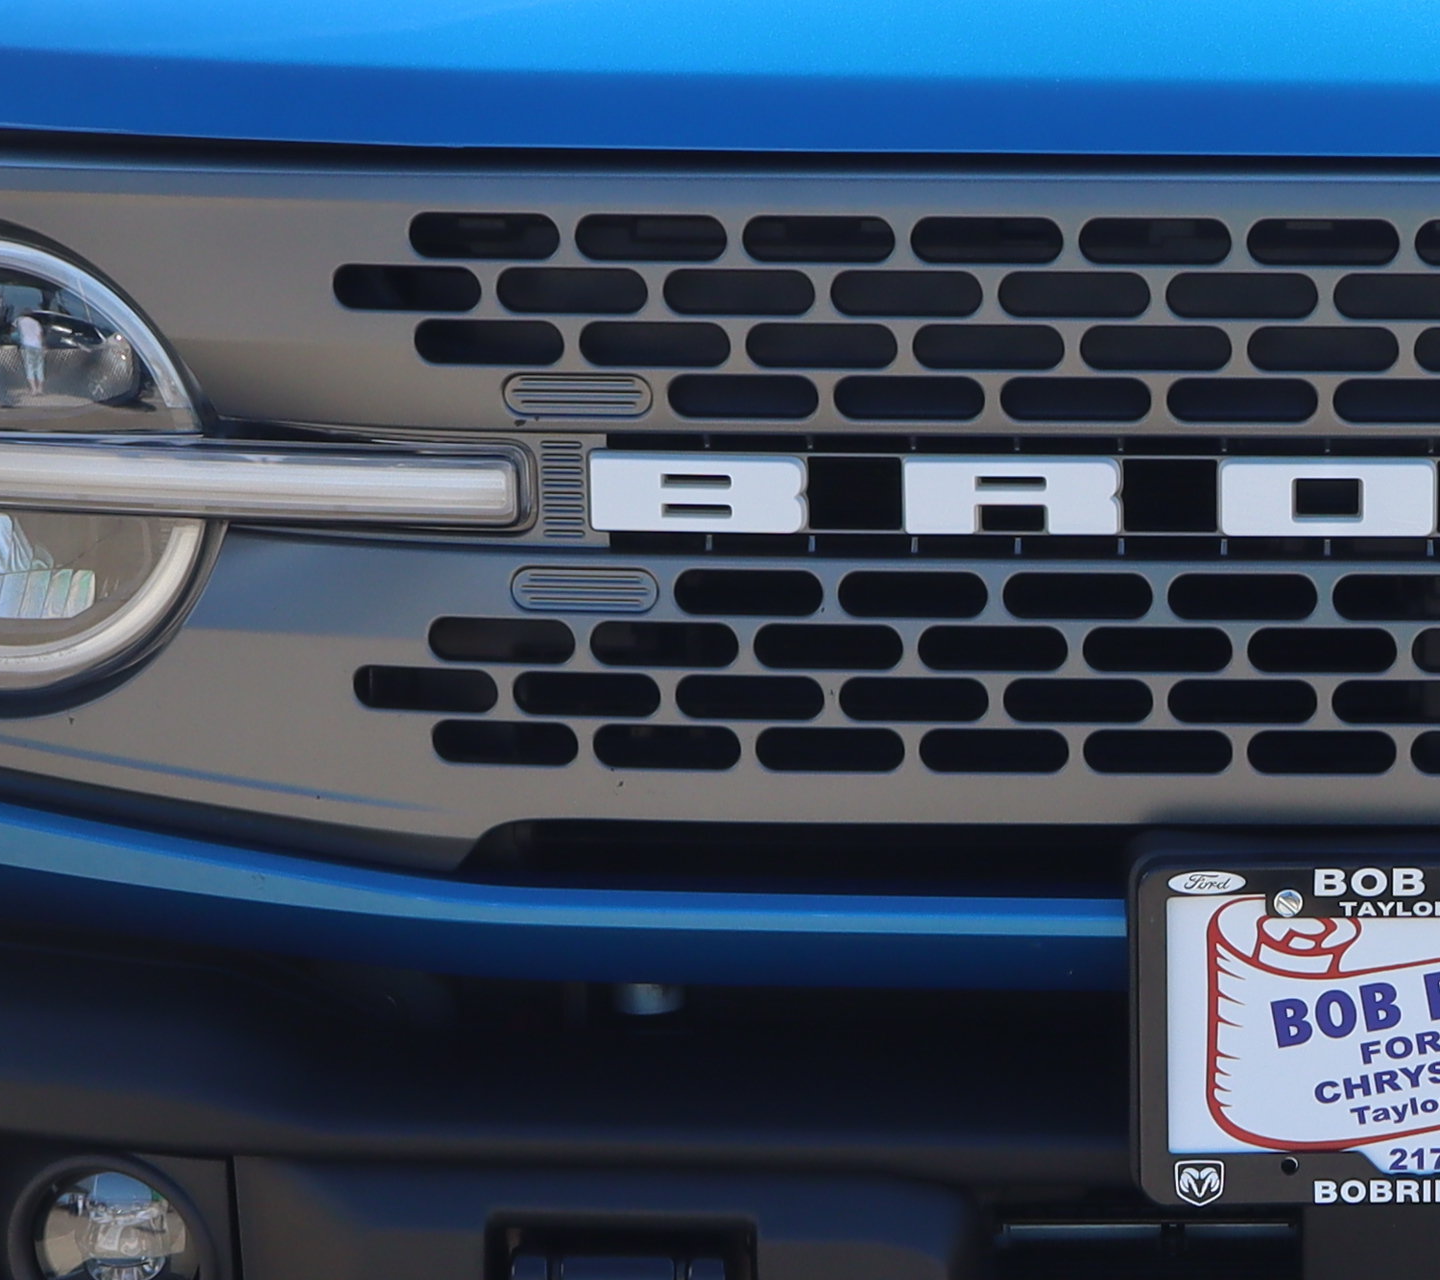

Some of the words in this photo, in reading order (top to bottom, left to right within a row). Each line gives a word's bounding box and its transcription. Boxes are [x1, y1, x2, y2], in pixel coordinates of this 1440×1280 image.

[1186, 873, 1231, 891] Ford
[1313, 868, 1426, 897] BOB
[1270, 981, 1402, 1048] BOB
